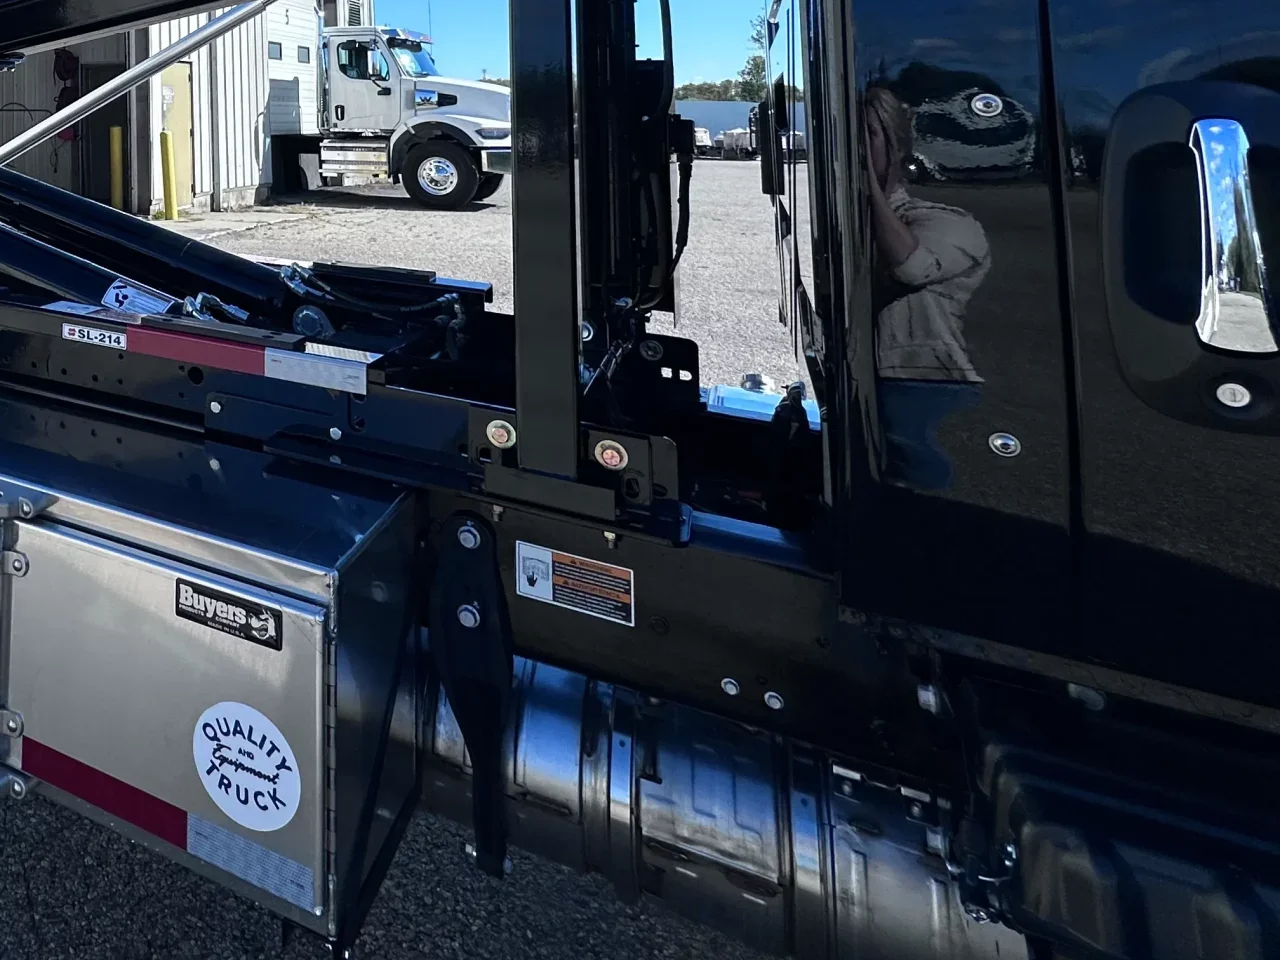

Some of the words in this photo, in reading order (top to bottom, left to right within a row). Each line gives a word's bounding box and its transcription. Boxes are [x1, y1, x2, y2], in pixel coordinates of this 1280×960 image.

[78, 329, 121, 345] SL-214
[179, 583, 247, 625] Buyers
[202, 717, 293, 773] QUALITY
[211, 742, 280, 785] Equipment
[238, 747, 255, 761] AND
[205, 759, 287, 811] TRUCK
